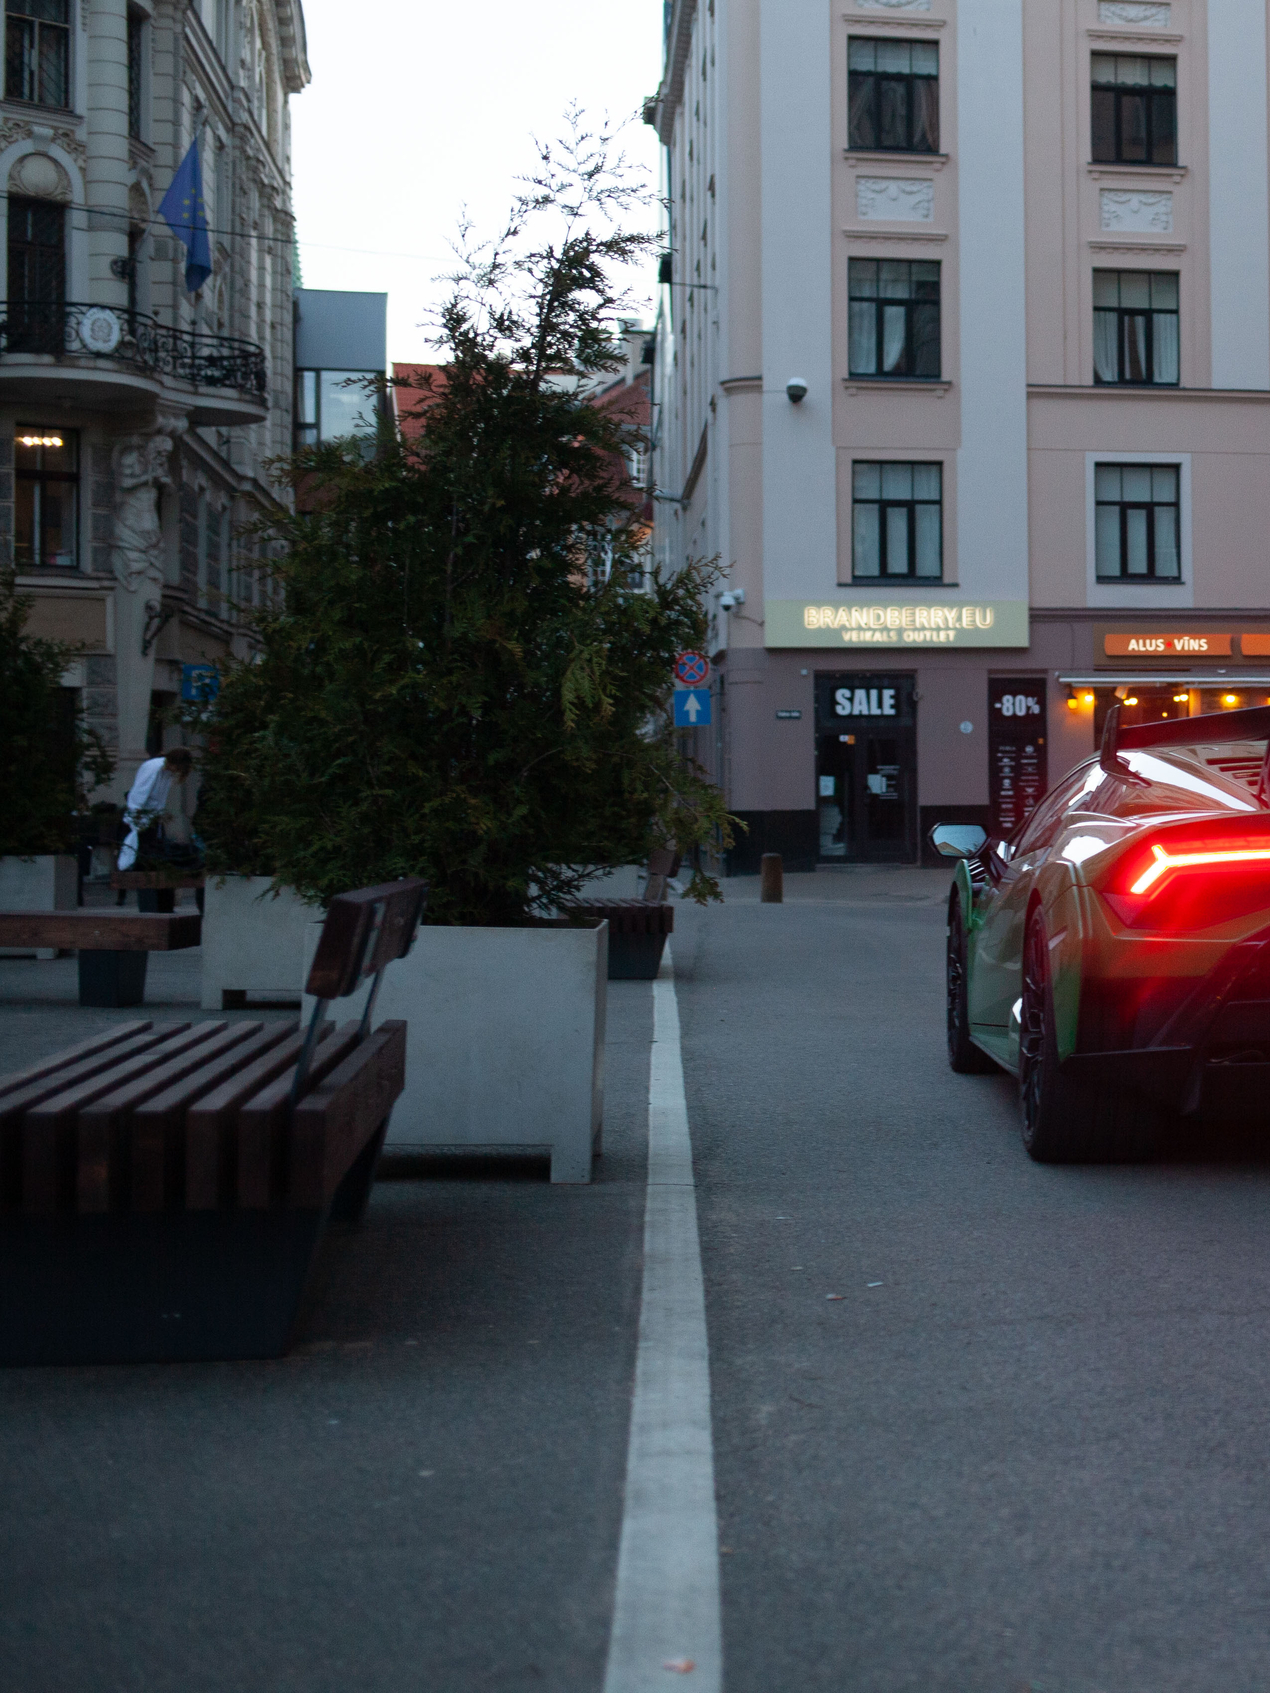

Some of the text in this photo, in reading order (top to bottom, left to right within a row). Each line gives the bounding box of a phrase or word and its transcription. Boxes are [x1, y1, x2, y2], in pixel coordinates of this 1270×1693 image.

[804, 606, 994, 629] BRANDBERRY.EU
[842, 630, 956, 642] VEIKALS OUTLET
[1128, 637, 1208, 651] ALUS VĪNS
[834, 688, 896, 716] SALE
[994, 694, 1041, 717] -80%
